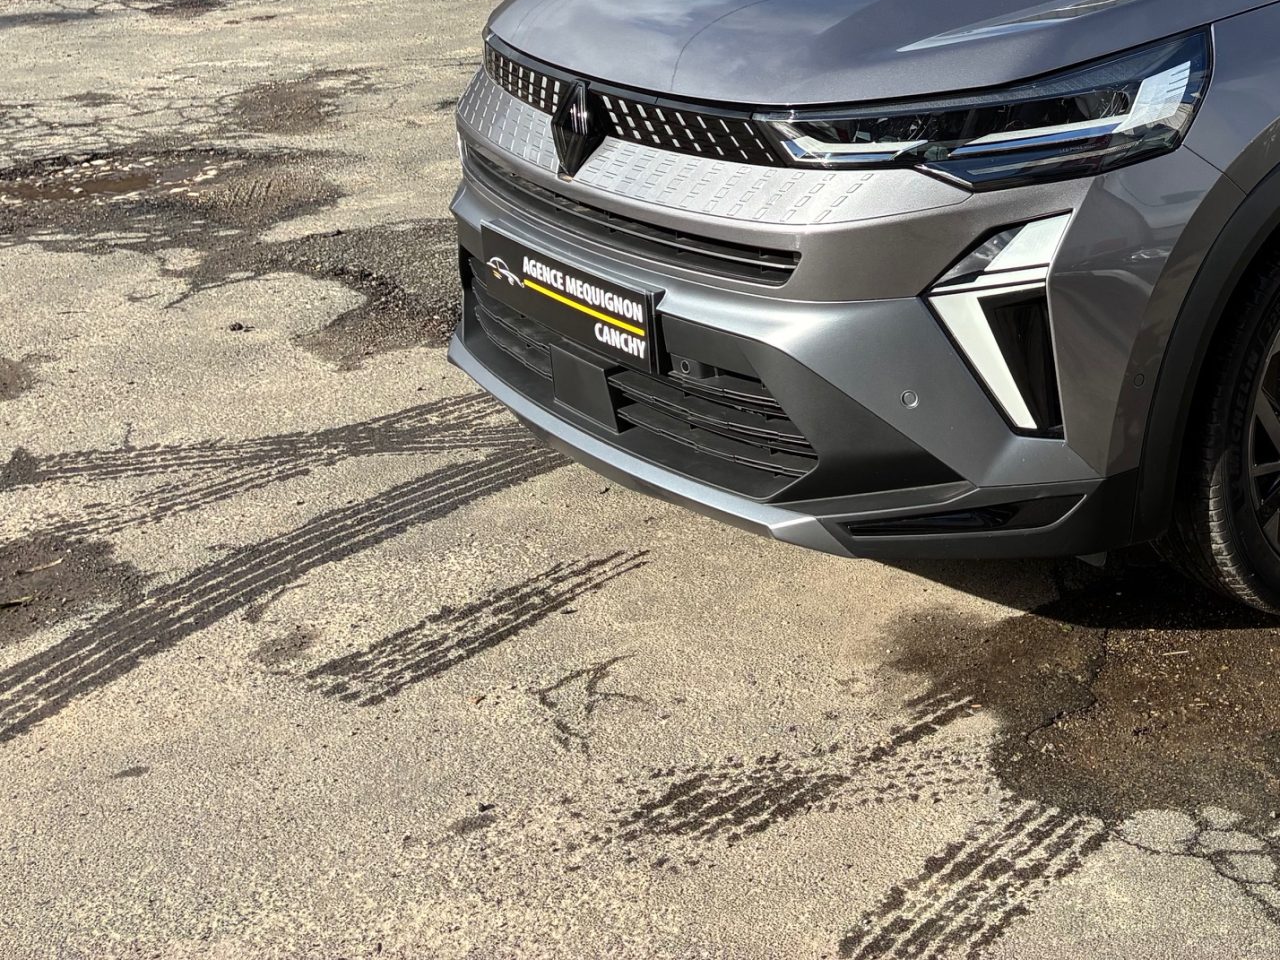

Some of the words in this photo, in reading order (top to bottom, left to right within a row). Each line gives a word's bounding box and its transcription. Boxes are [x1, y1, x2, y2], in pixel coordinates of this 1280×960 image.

[522, 256, 565, 290] AGENCE
[565, 275, 644, 323] MEQUIGNON
[594, 322, 646, 359] CANCHY
